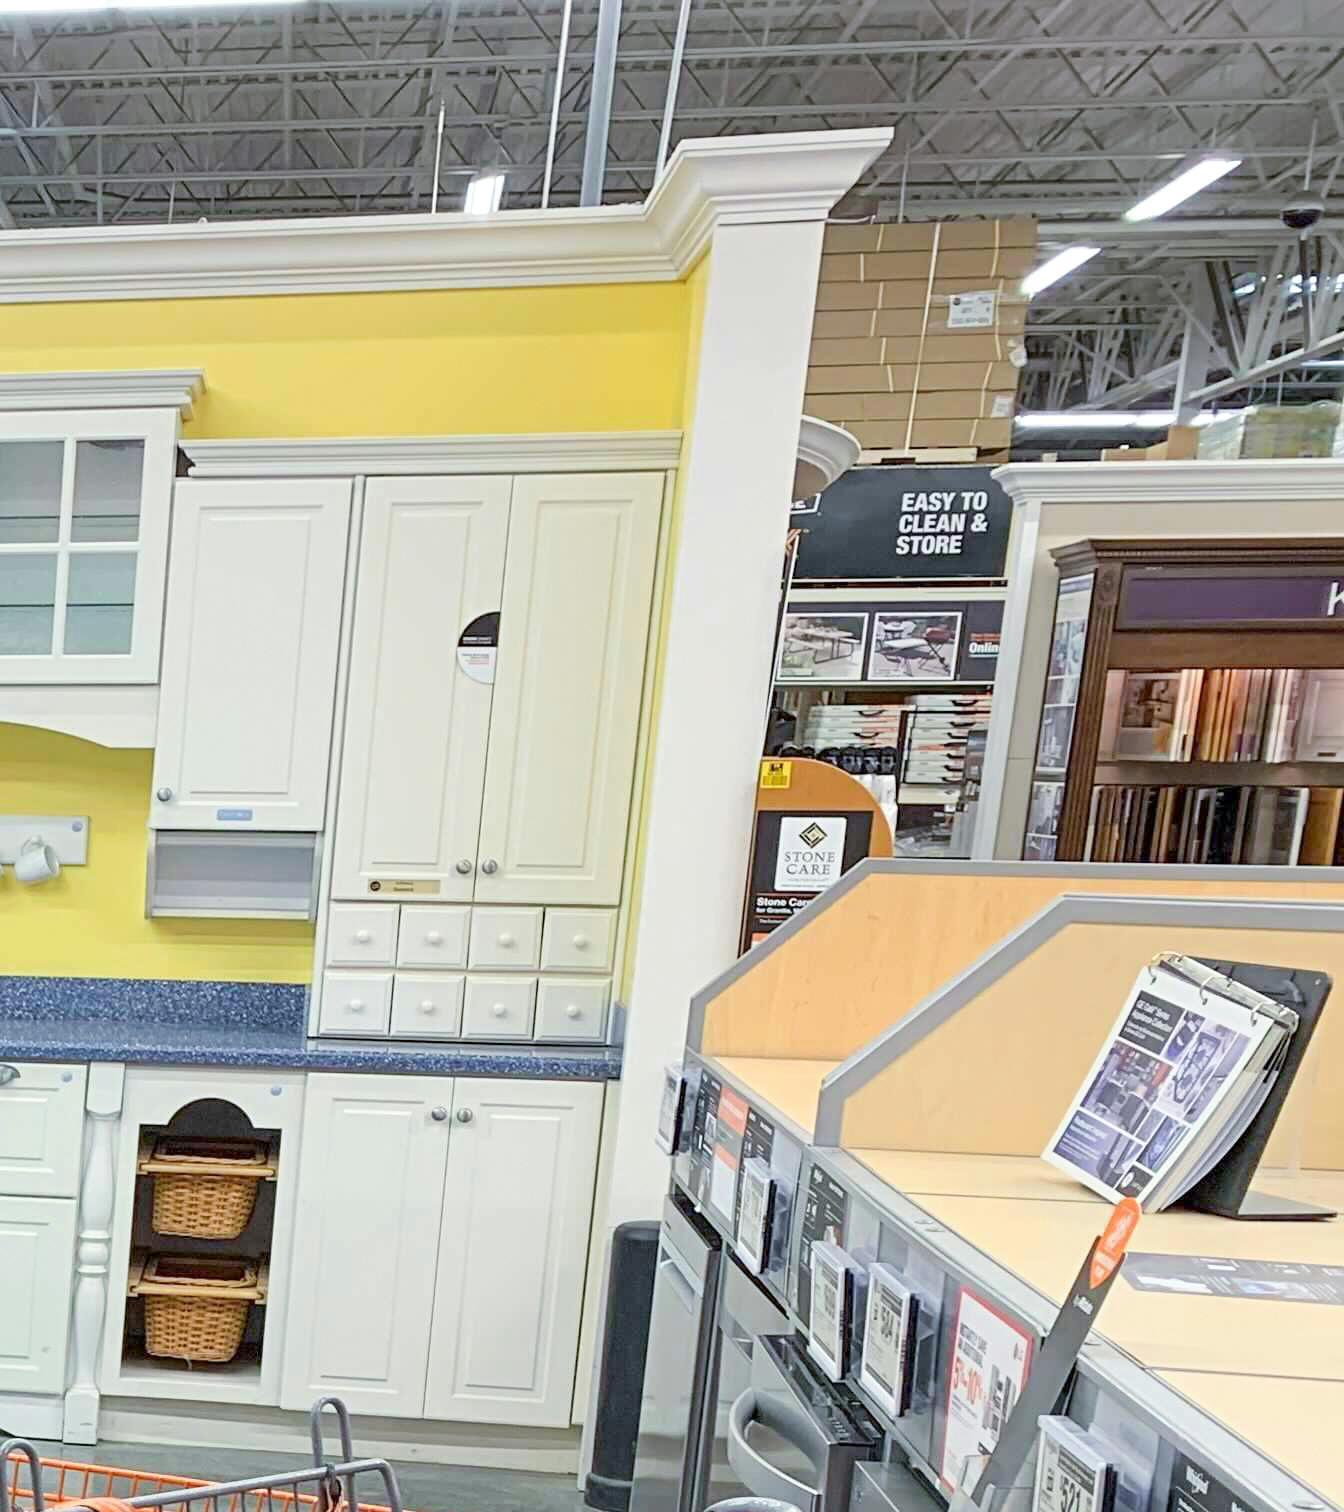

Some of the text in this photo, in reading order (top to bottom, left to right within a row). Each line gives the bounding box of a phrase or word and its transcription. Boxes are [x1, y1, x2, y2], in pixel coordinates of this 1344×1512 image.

[901, 492, 987, 512] EASY TO
[899, 514, 988, 533] CLEAN &
[896, 535, 962, 555] STORE
[784, 851, 835, 863] STONE
[786, 863, 831, 875] CARE
[757, 897, 786, 906] Stone
